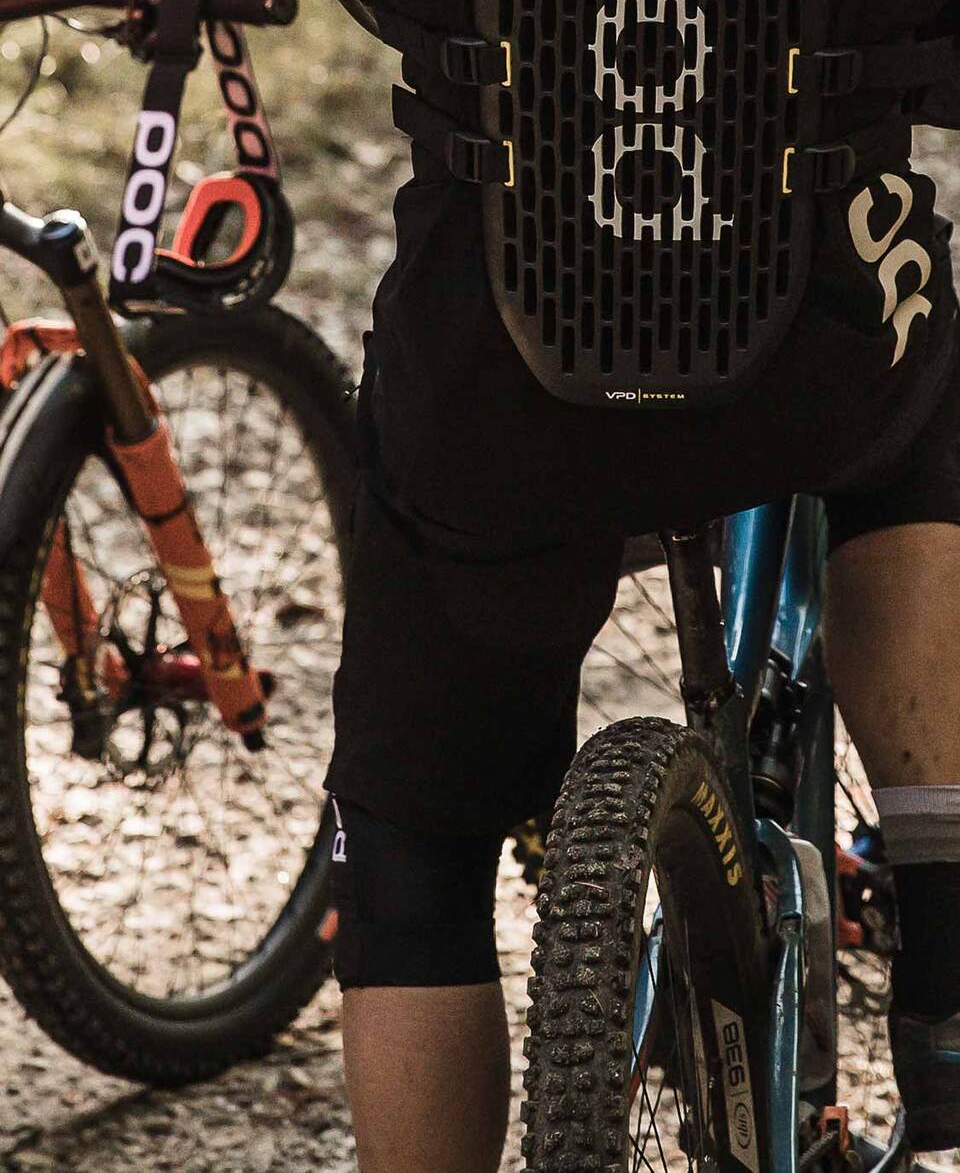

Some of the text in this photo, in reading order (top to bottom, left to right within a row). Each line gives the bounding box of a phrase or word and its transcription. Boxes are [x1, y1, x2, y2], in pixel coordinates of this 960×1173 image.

[111, 109, 176, 284] POC
[605, 391, 637, 400] VPD
[690, 781, 744, 887] MAXXIS
